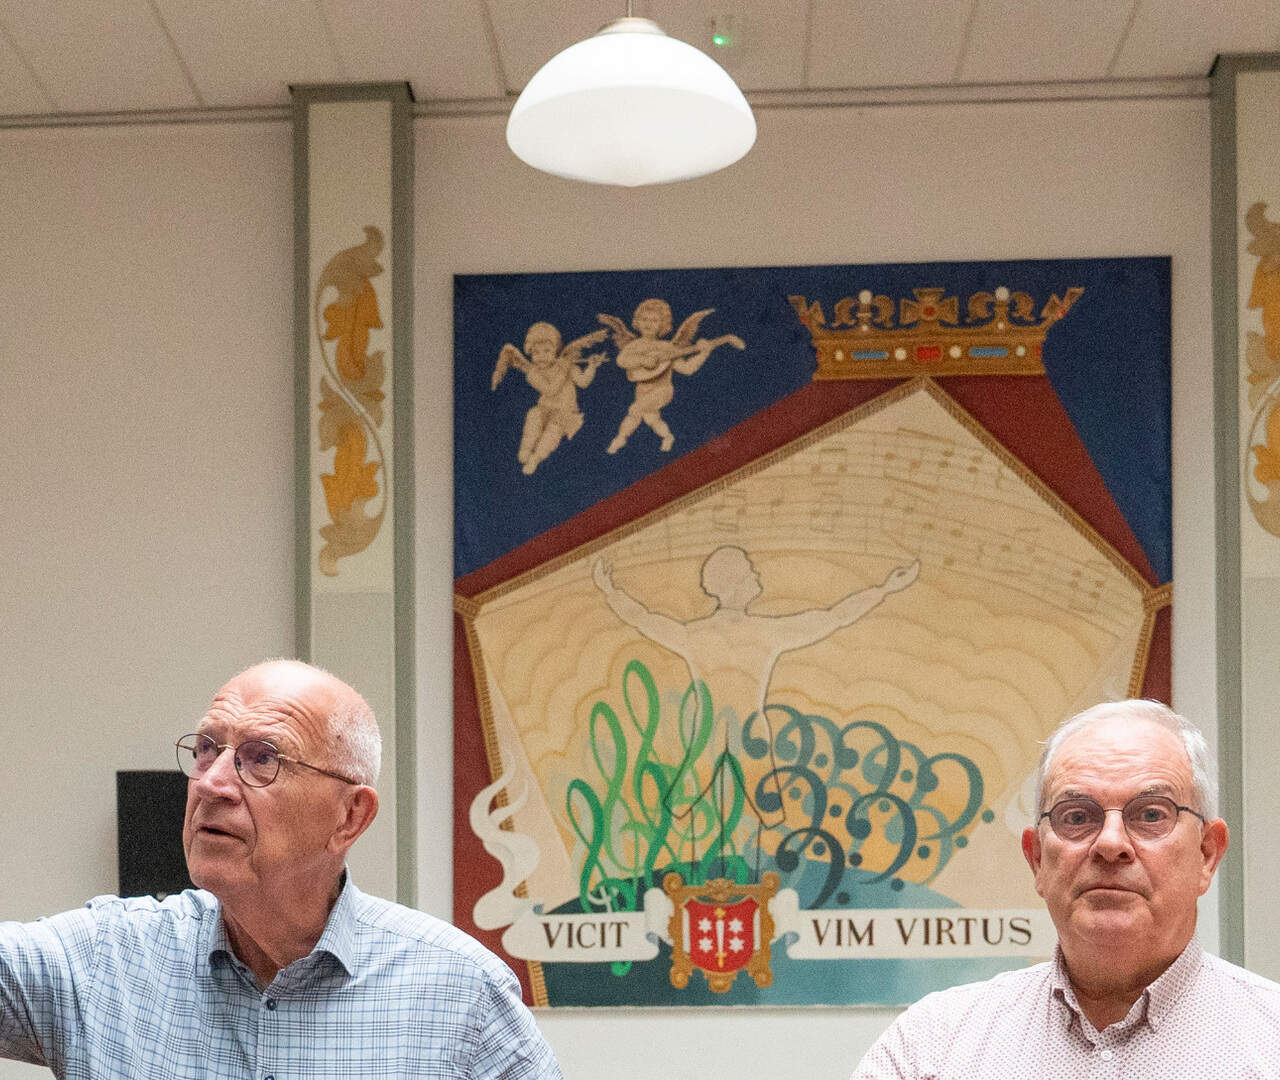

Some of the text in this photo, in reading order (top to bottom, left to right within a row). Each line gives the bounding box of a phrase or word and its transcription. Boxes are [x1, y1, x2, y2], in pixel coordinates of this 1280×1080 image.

[542, 917, 1032, 949] VICIT VIM VIRTUS
